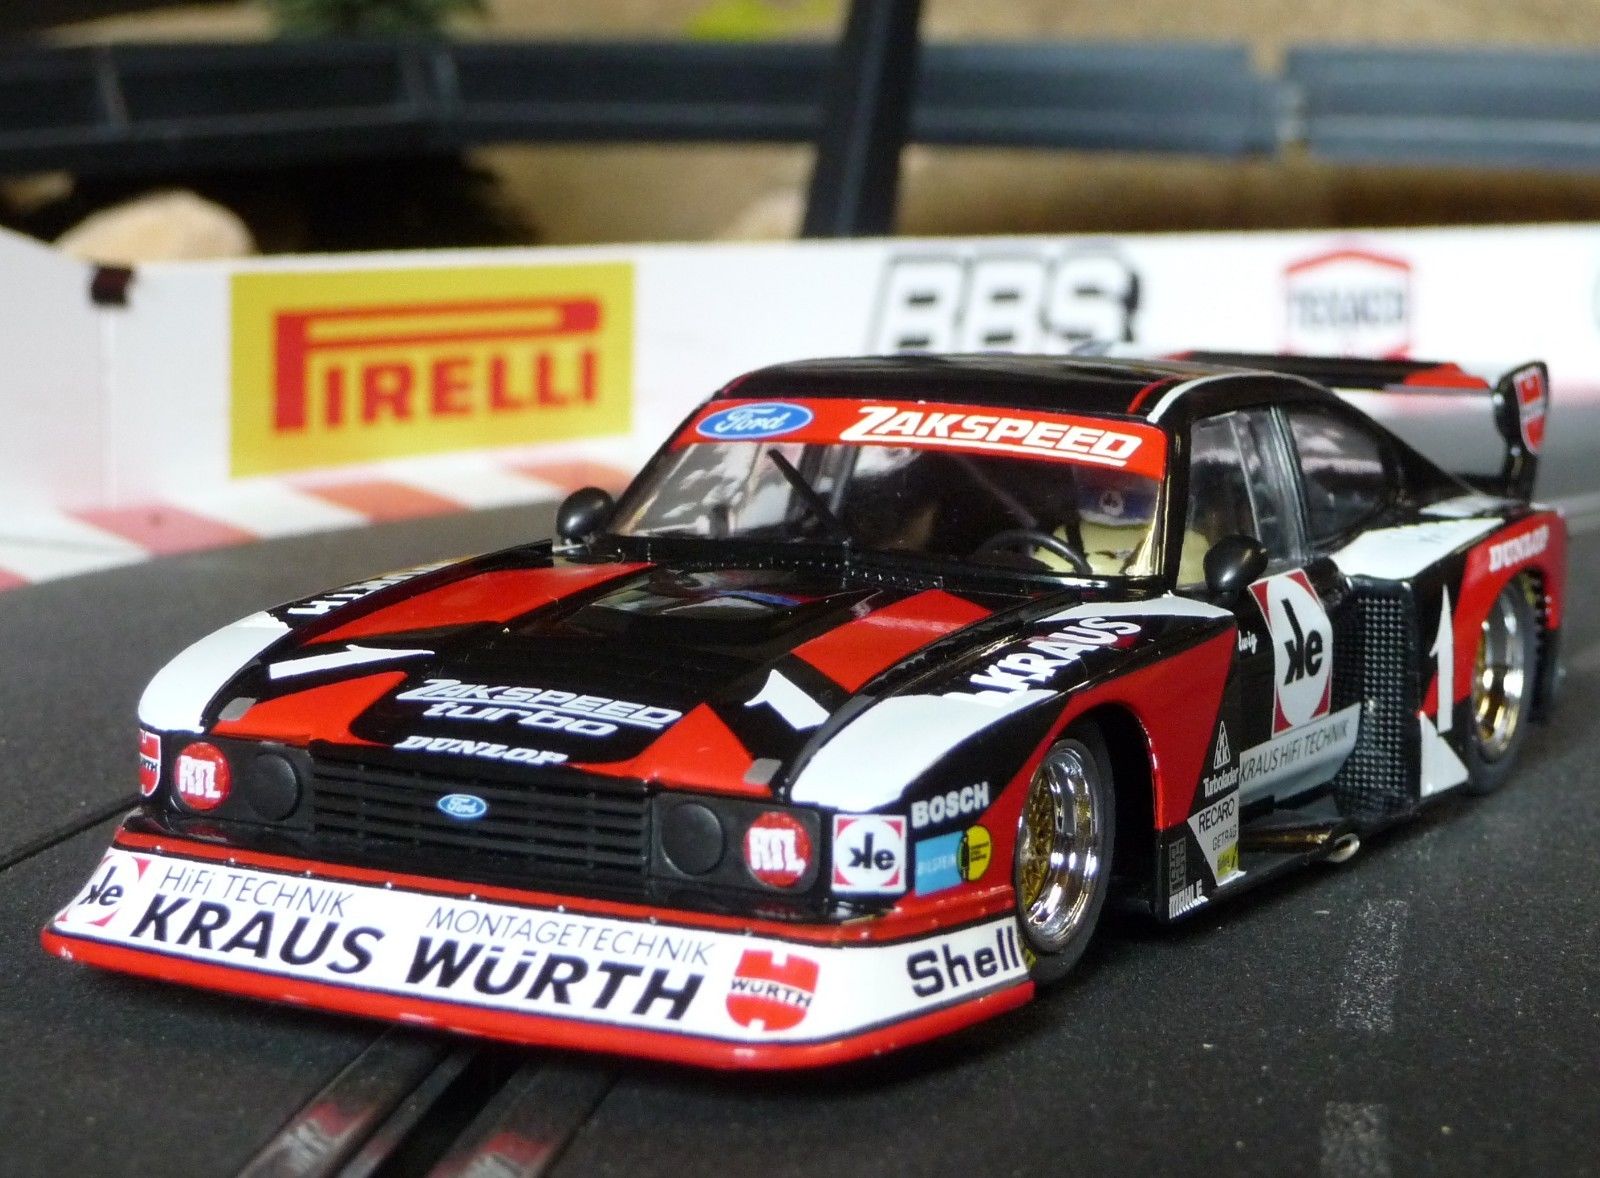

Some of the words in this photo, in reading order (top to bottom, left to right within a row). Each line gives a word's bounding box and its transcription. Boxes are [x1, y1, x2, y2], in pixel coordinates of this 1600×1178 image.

[273, 297, 602, 433] PIRELLI
[714, 407, 791, 432] Ford
[839, 405, 1143, 468] ZAKSPEED
[1429, 585, 1454, 733] 1
[396, 679, 683, 730] ZAKSPEED
[422, 702, 618, 737] turbo
[392, 735, 569, 766] DUNLOP
[179, 755, 221, 799] RTL
[911, 781, 990, 829] BOSCH
[1198, 797, 1236, 834] RECARO
[750, 826, 808, 873] RTL
[222, 873, 353, 917] TECHNIK
[130, 892, 385, 974] KRAUS
[427, 906, 715, 966] MONTAGETECHNIK
[406, 935, 704, 1019] WÜRTH
[906, 926, 1020, 998] Shell
